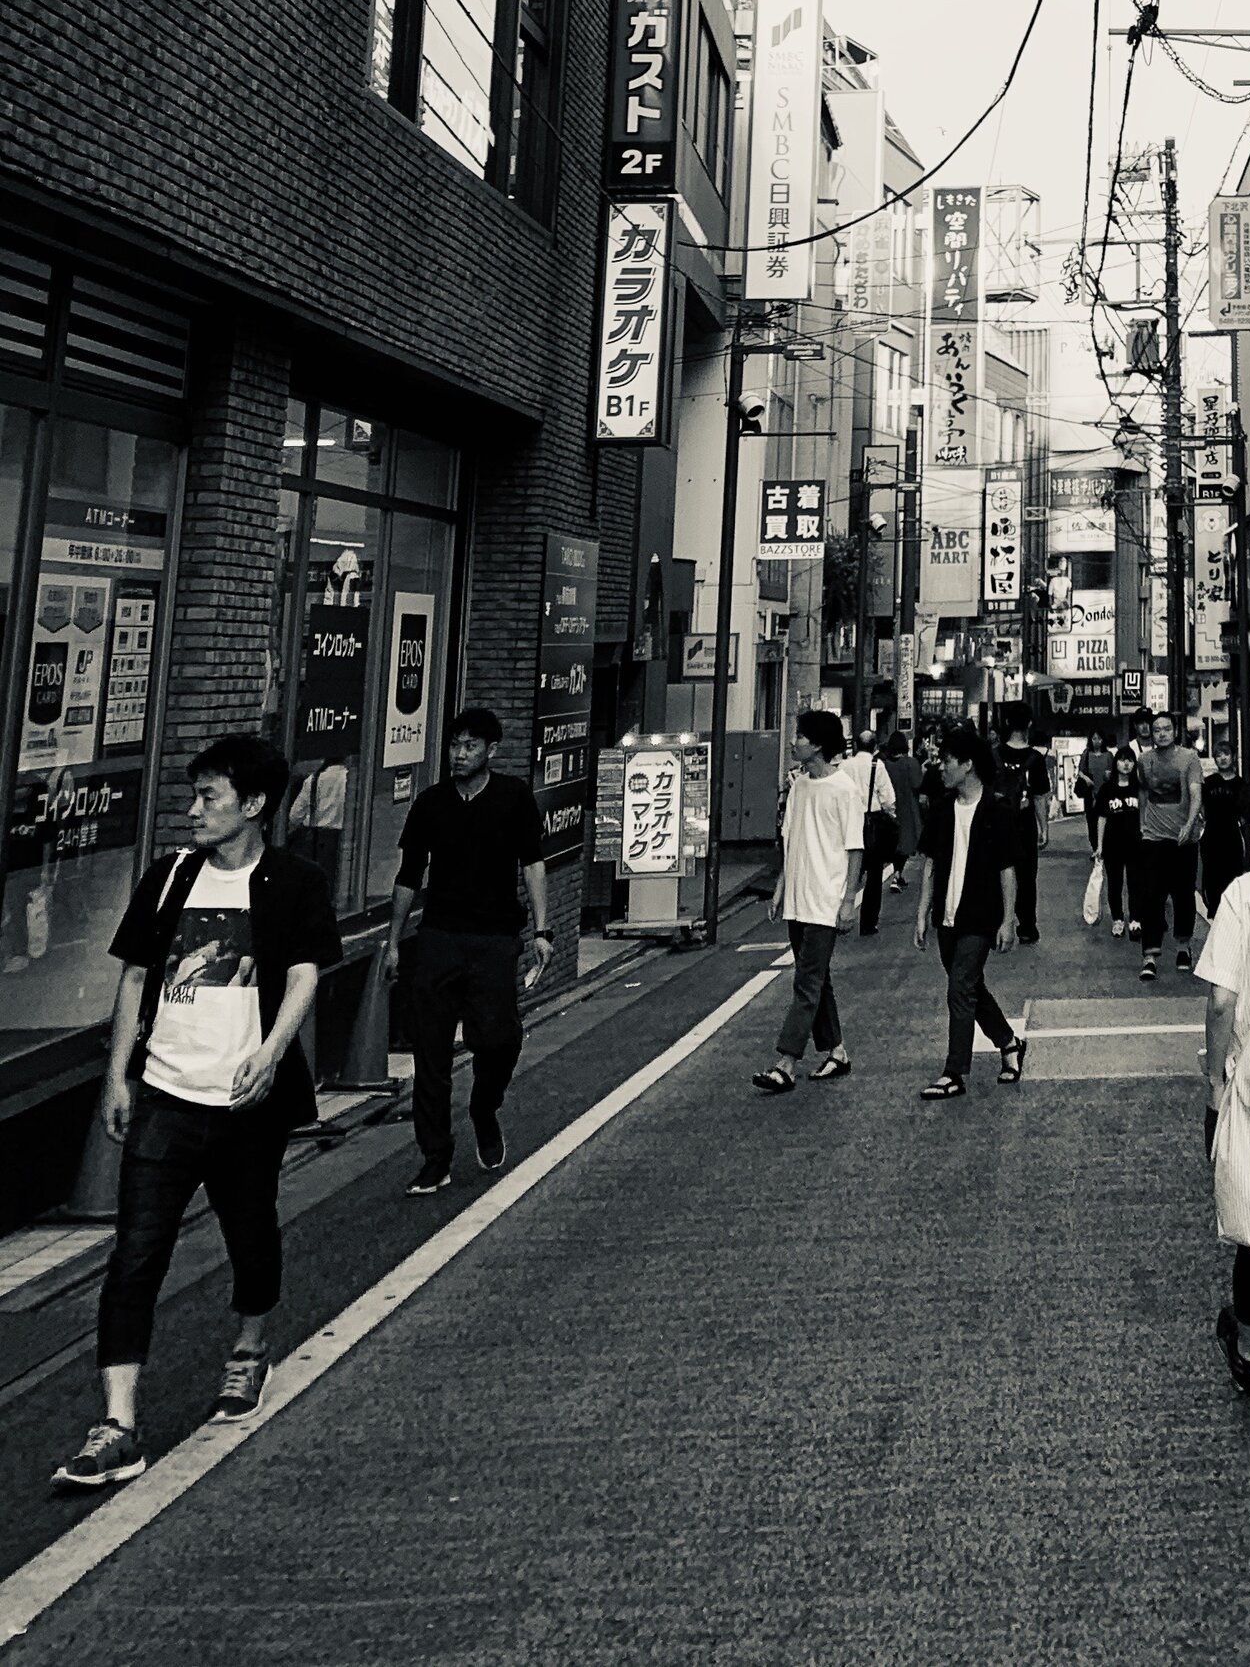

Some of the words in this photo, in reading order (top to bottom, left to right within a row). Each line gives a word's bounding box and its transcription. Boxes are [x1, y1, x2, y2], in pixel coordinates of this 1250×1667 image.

[627, 8, 669, 133] ガスト
[621, 149, 662, 175] 2F
[766, 87, 794, 278] SMBC日興証券
[937, 194, 976, 209] しもきた
[944, 212, 968, 315] 空間リバティ
[606, 222, 660, 388] カラオケ
[606, 394, 650, 418] B1F
[1202, 395, 1219, 467] 星乃珈店
[766, 485, 821, 510] 古着
[86, 508, 135, 527] ATMコーナー
[765, 515, 820, 540] 買取
[760, 544, 821, 555] BAZZSTORE
[930, 530, 969, 550] ABC
[930, 551, 969, 564] MART
[312, 632, 363, 658] コインロッカー
[400, 639, 424, 668] EPOS
[1077, 639, 1109, 654] PIZZA
[34, 663, 63, 687] EPOS
[401, 674, 419, 690] CARD
[306, 706, 358, 733] ATMコーナー
[35, 783, 123, 823] コインロッカー
[651, 772, 675, 852] カラオケ
[629, 803, 650, 860] マック
